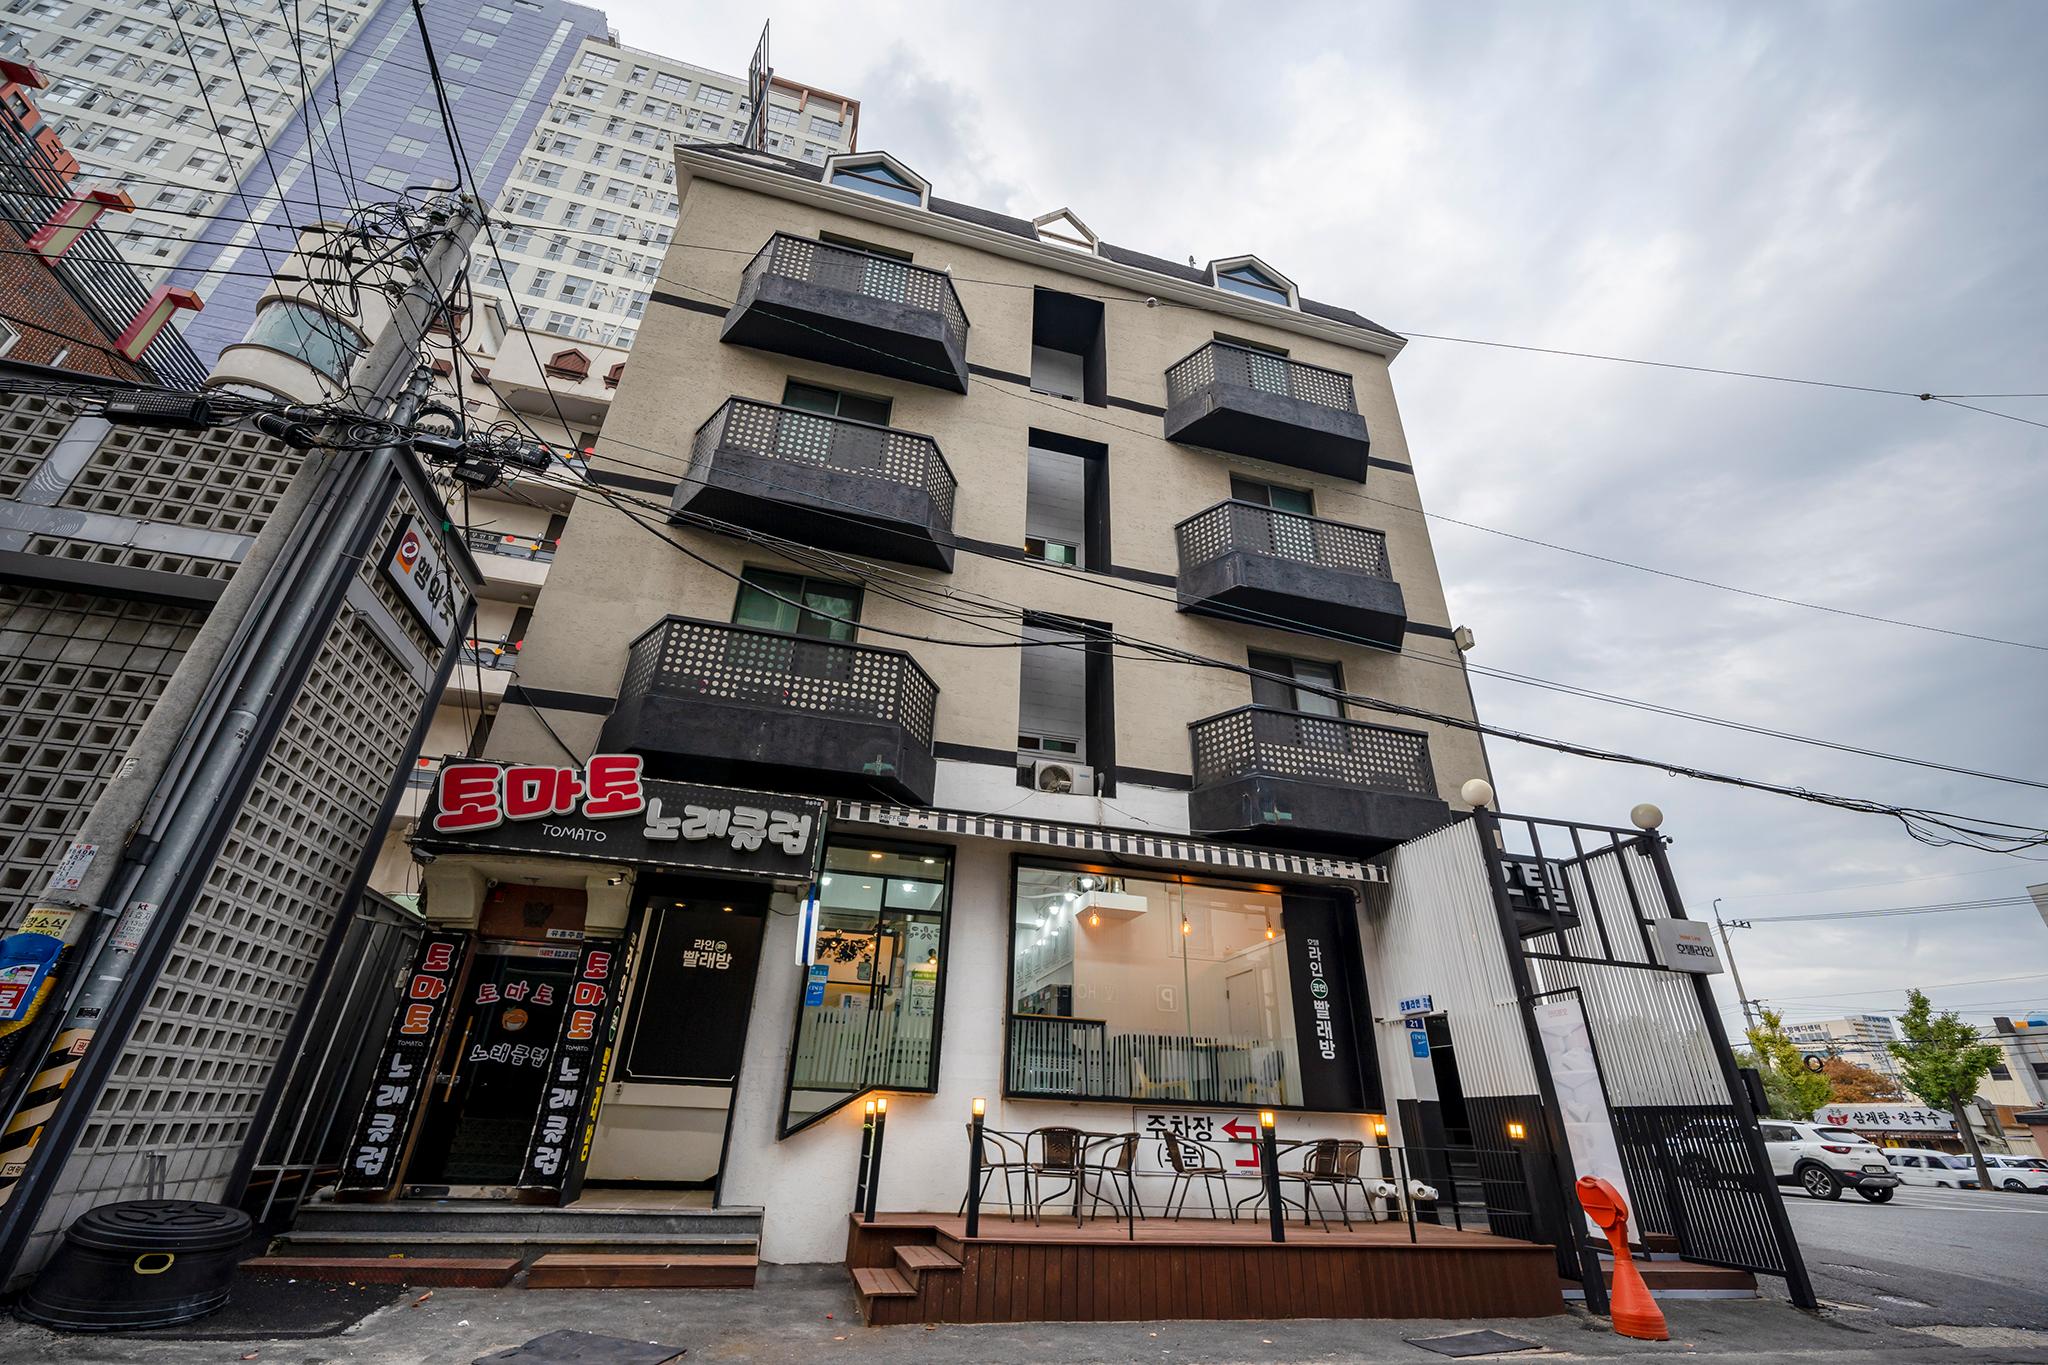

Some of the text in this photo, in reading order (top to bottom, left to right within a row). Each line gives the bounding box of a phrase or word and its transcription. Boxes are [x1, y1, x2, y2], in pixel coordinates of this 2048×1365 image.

[433, 754, 812, 856] 토마토 노래클럽
[541, 823, 606, 842] TOMATO
[694, 939, 715, 950] 라인
[1676, 943, 1714, 957] 호텔라인
[683, 950, 733, 970] 빨래방
[1308, 946, 1323, 977] 라인
[400, 942, 454, 1034] 토마토
[476, 980, 554, 1006] 토마토
[567, 951, 612, 1040] 토마토
[1313, 1000, 1335, 1060] 빨래방
[1410, 1020, 1419, 1028] 21
[469, 1043, 549, 1068] 노래클럽
[356, 1053, 413, 1176] 노래클럽
[534, 1057, 580, 1176] 노래클럽
[1146, 1115, 1213, 1141] 주차장
